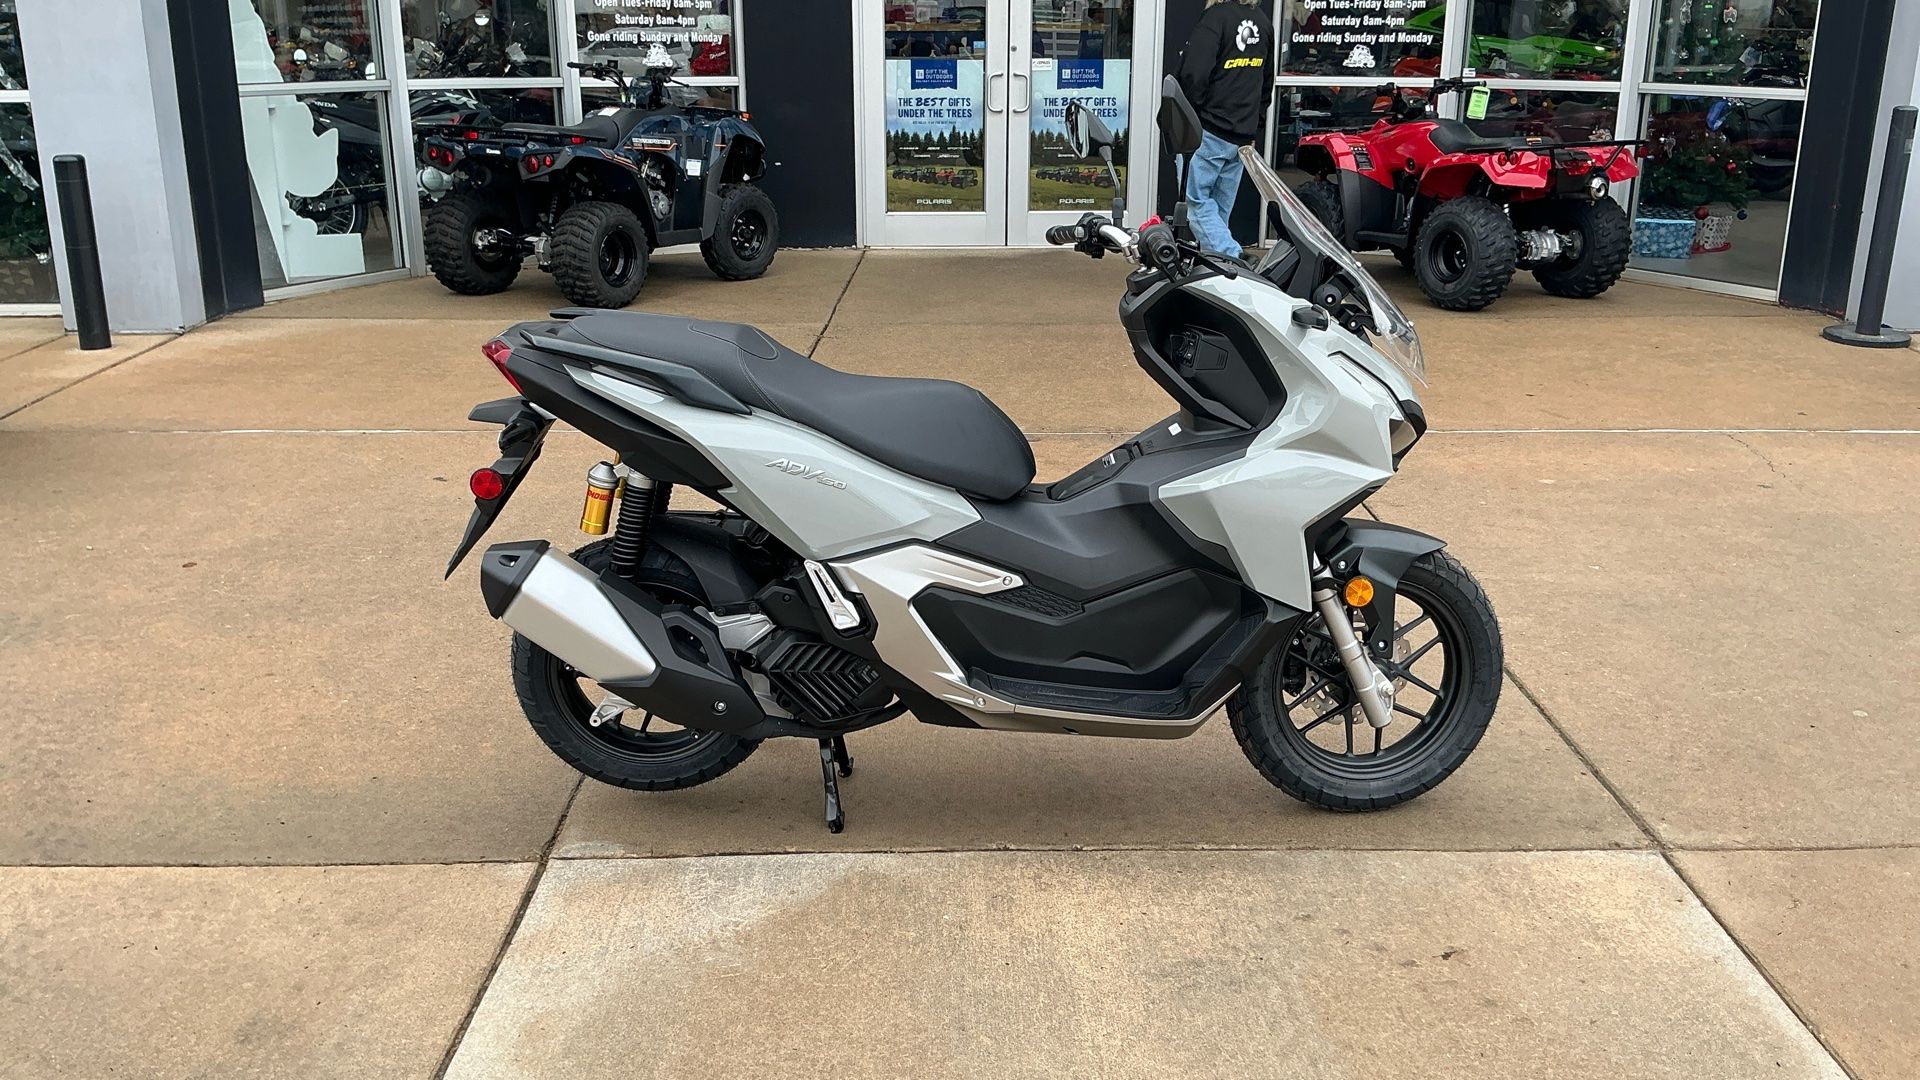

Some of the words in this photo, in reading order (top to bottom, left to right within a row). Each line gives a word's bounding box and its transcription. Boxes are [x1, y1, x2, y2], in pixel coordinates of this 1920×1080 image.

[595, 0, 618, 10] Open
[621, 0, 671, 10] Tues-Friday
[673, 0, 712, 10] 8am-5pm
[1304, 0, 1326, 11] Open
[1329, 0, 1382, 11] Tues-Friday
[1383, 0, 1426, 11] 8am-5pm
[615, 14, 654, 27] Saturday
[655, 14, 695, 26] 8am-4pm
[1321, 15, 1361, 28] Saturday
[1363, 15, 1405, 27] 8am-4pm
[587, 30, 610, 42] Gone
[613, 31, 638, 44] riding
[640, 31, 671, 44] Sunday
[673, 31, 689, 42] and
[690, 31, 723, 44] Monday
[1292, 32, 1315, 43] Gone
[1316, 32, 1342, 45] riding
[1343, 32, 1377, 45] Sunday
[1378, 32, 1396, 43] and
[1397, 32, 1434, 45] Monday
[898, 97, 913, 107] THE
[915, 97, 948, 107] BEST
[948, 97, 971, 107] GIFTS
[1044, 97, 1059, 107] THE
[1094, 97, 1117, 107] GIFTS
[898, 109, 925, 118] UNDER
[926, 109, 944, 118] THE
[945, 109, 972, 118] TREES
[1043, 109, 1065, 118] UNDE
